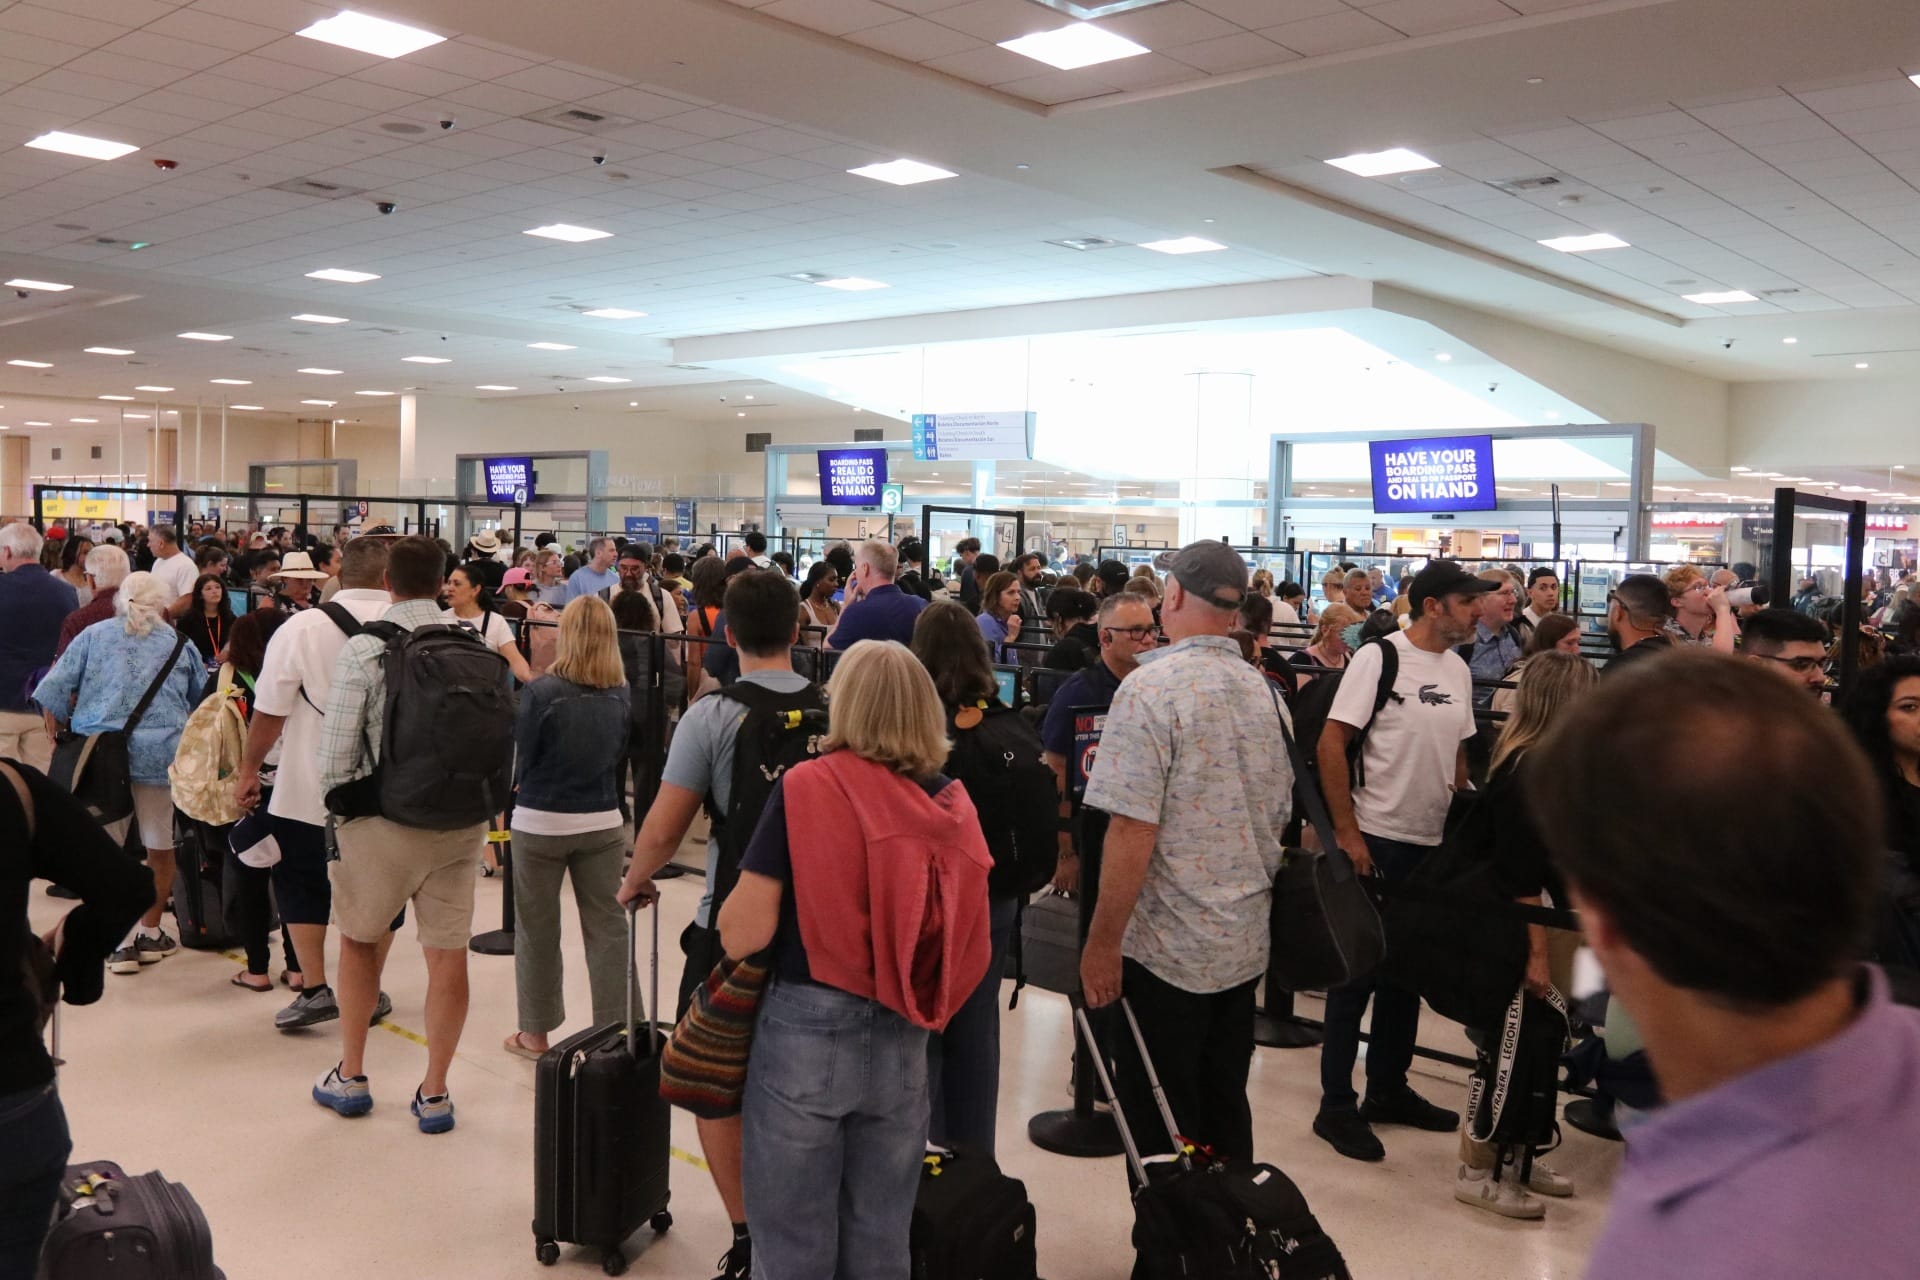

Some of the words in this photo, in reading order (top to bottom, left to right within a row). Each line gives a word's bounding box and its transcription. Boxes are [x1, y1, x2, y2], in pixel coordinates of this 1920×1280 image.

[1384, 451, 1427, 466] HAVE
[1430, 449, 1475, 464] YOUR
[490, 466, 506, 474] HAVE
[507, 464, 526, 473] YOUR
[837, 467, 856, 475] REAL
[858, 467, 865, 475] ID
[867, 466, 874, 475] O
[1386, 465, 1445, 477] BOARDING
[1447, 463, 1476, 474] PASS
[831, 476, 875, 485] PASAPORTE
[492, 485, 504, 494] ON
[517, 490, 524, 502] 4
[832, 486, 843, 496] EN
[846, 485, 875, 496] MANO
[1388, 483, 1416, 500] ON
[1421, 482, 1478, 499] HAND
[885, 489, 897, 505] 3
[1005, 528, 1012, 541] 4
[1117, 532, 1125, 545] 5
[1076, 716, 1093, 731] NO
[1503, 1022, 1516, 1060] LEGION
